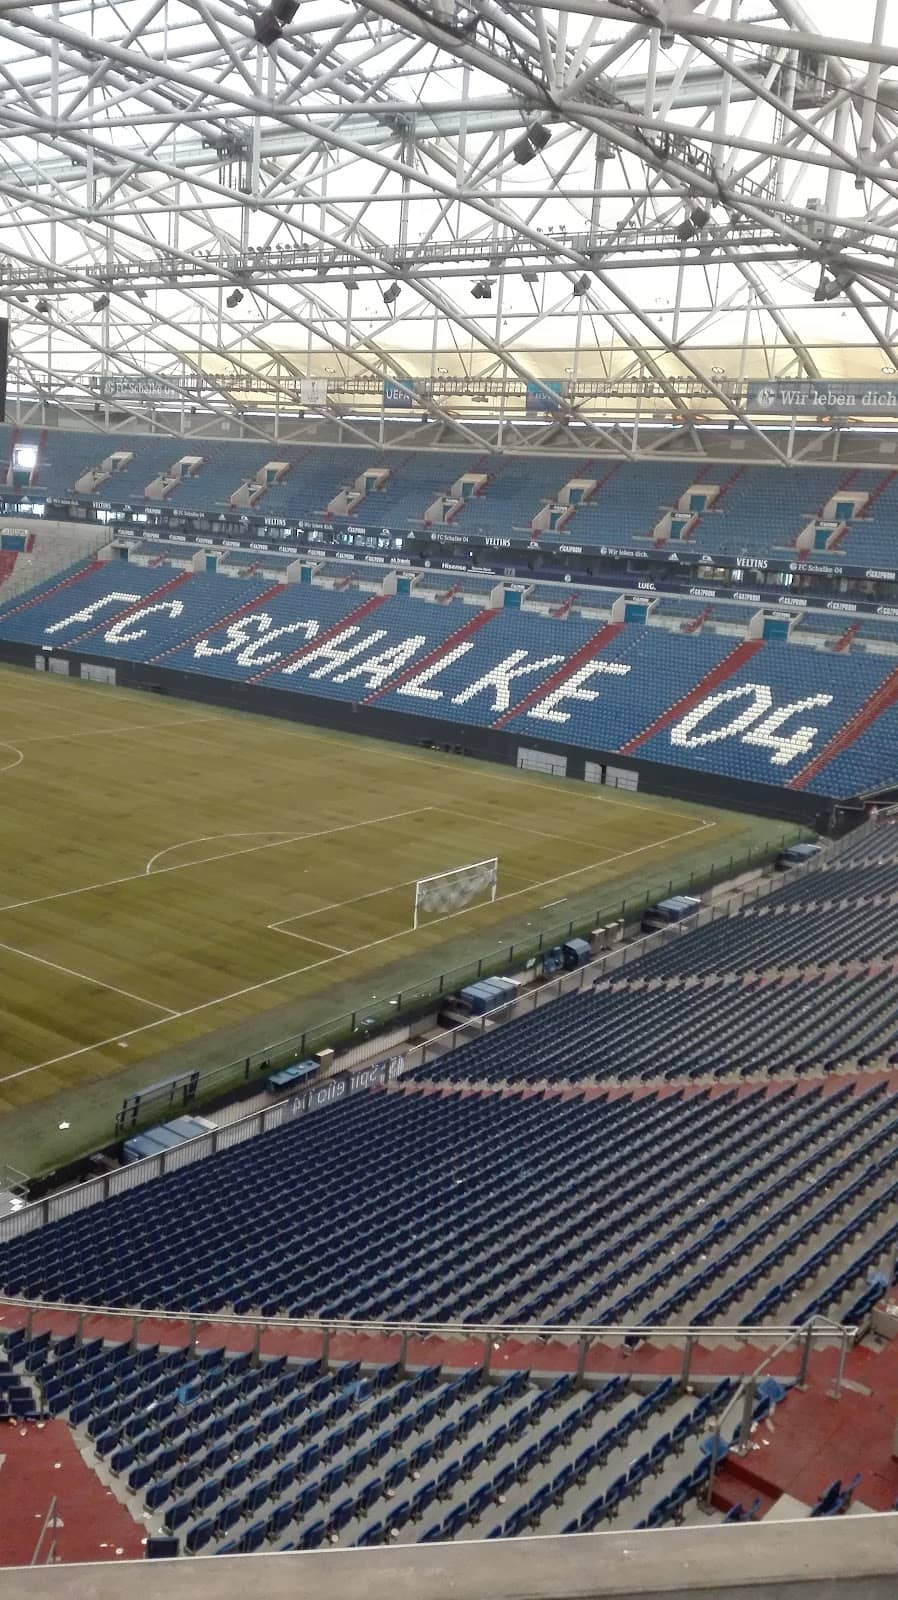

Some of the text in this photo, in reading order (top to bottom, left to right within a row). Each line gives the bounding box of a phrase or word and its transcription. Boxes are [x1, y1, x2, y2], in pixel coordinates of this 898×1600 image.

[781, 390, 897, 406] Wir leben dich
[485, 537, 511, 547] VELTINS
[442, 562, 466, 571] Hisense
[736, 557, 768, 569] VELTINS
[44, 591, 833, 765] FC SCHALKE 04
